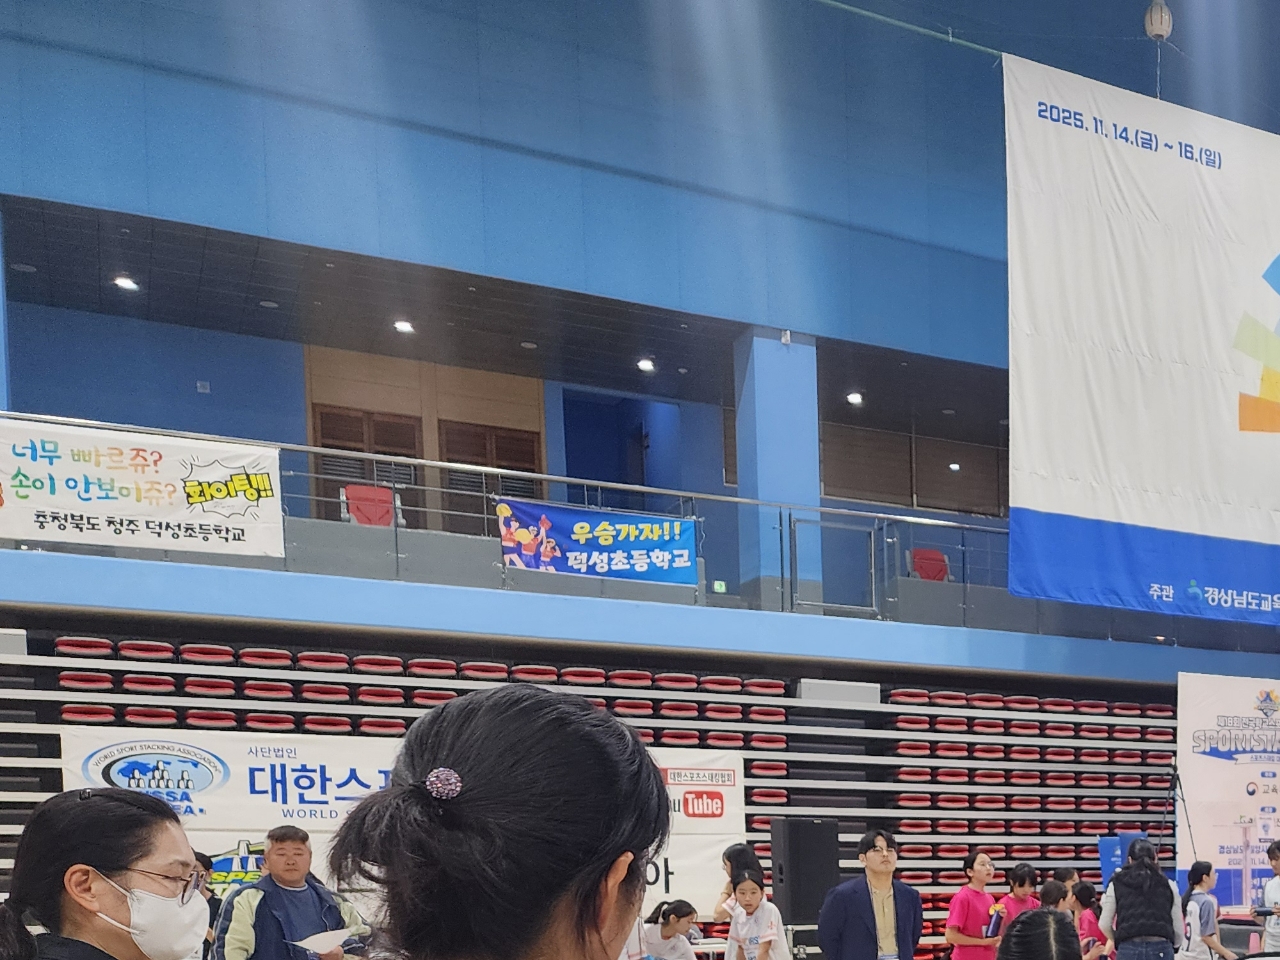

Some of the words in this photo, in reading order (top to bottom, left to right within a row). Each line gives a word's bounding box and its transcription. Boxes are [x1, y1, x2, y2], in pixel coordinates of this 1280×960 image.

[1037, 101, 1089, 131] 2025.
[1092, 116, 1109, 138] 11.
[1112, 123, 1159, 152] 14.(금)
[1178, 141, 1222, 170] 16.(일)
[12, 438, 62, 466] 너무
[70, 447, 163, 475] 빠르쥬?
[10, 466, 57, 499] 손이
[65, 474, 177, 506] 안보이쥬?
[34, 510, 101, 532] 충청북도
[105, 516, 141, 535] 청주
[145, 520, 246, 543] 덕성초등학교
[571, 522, 681, 546] 우승가자!!
[566, 549, 691, 573] 덕성초등학교
[1149, 583, 1174, 602] 주관
[93, 751, 116, 767] WORLD
[117, 745, 138, 755] SPORT
[139, 743, 176, 752] STACKING
[247, 746, 297, 759] 사단법인
[669, 770, 733, 783] 대한스포츠스태킹협회
[281, 808, 338, 819] WORLD
[685, 793, 722, 815] Tube
